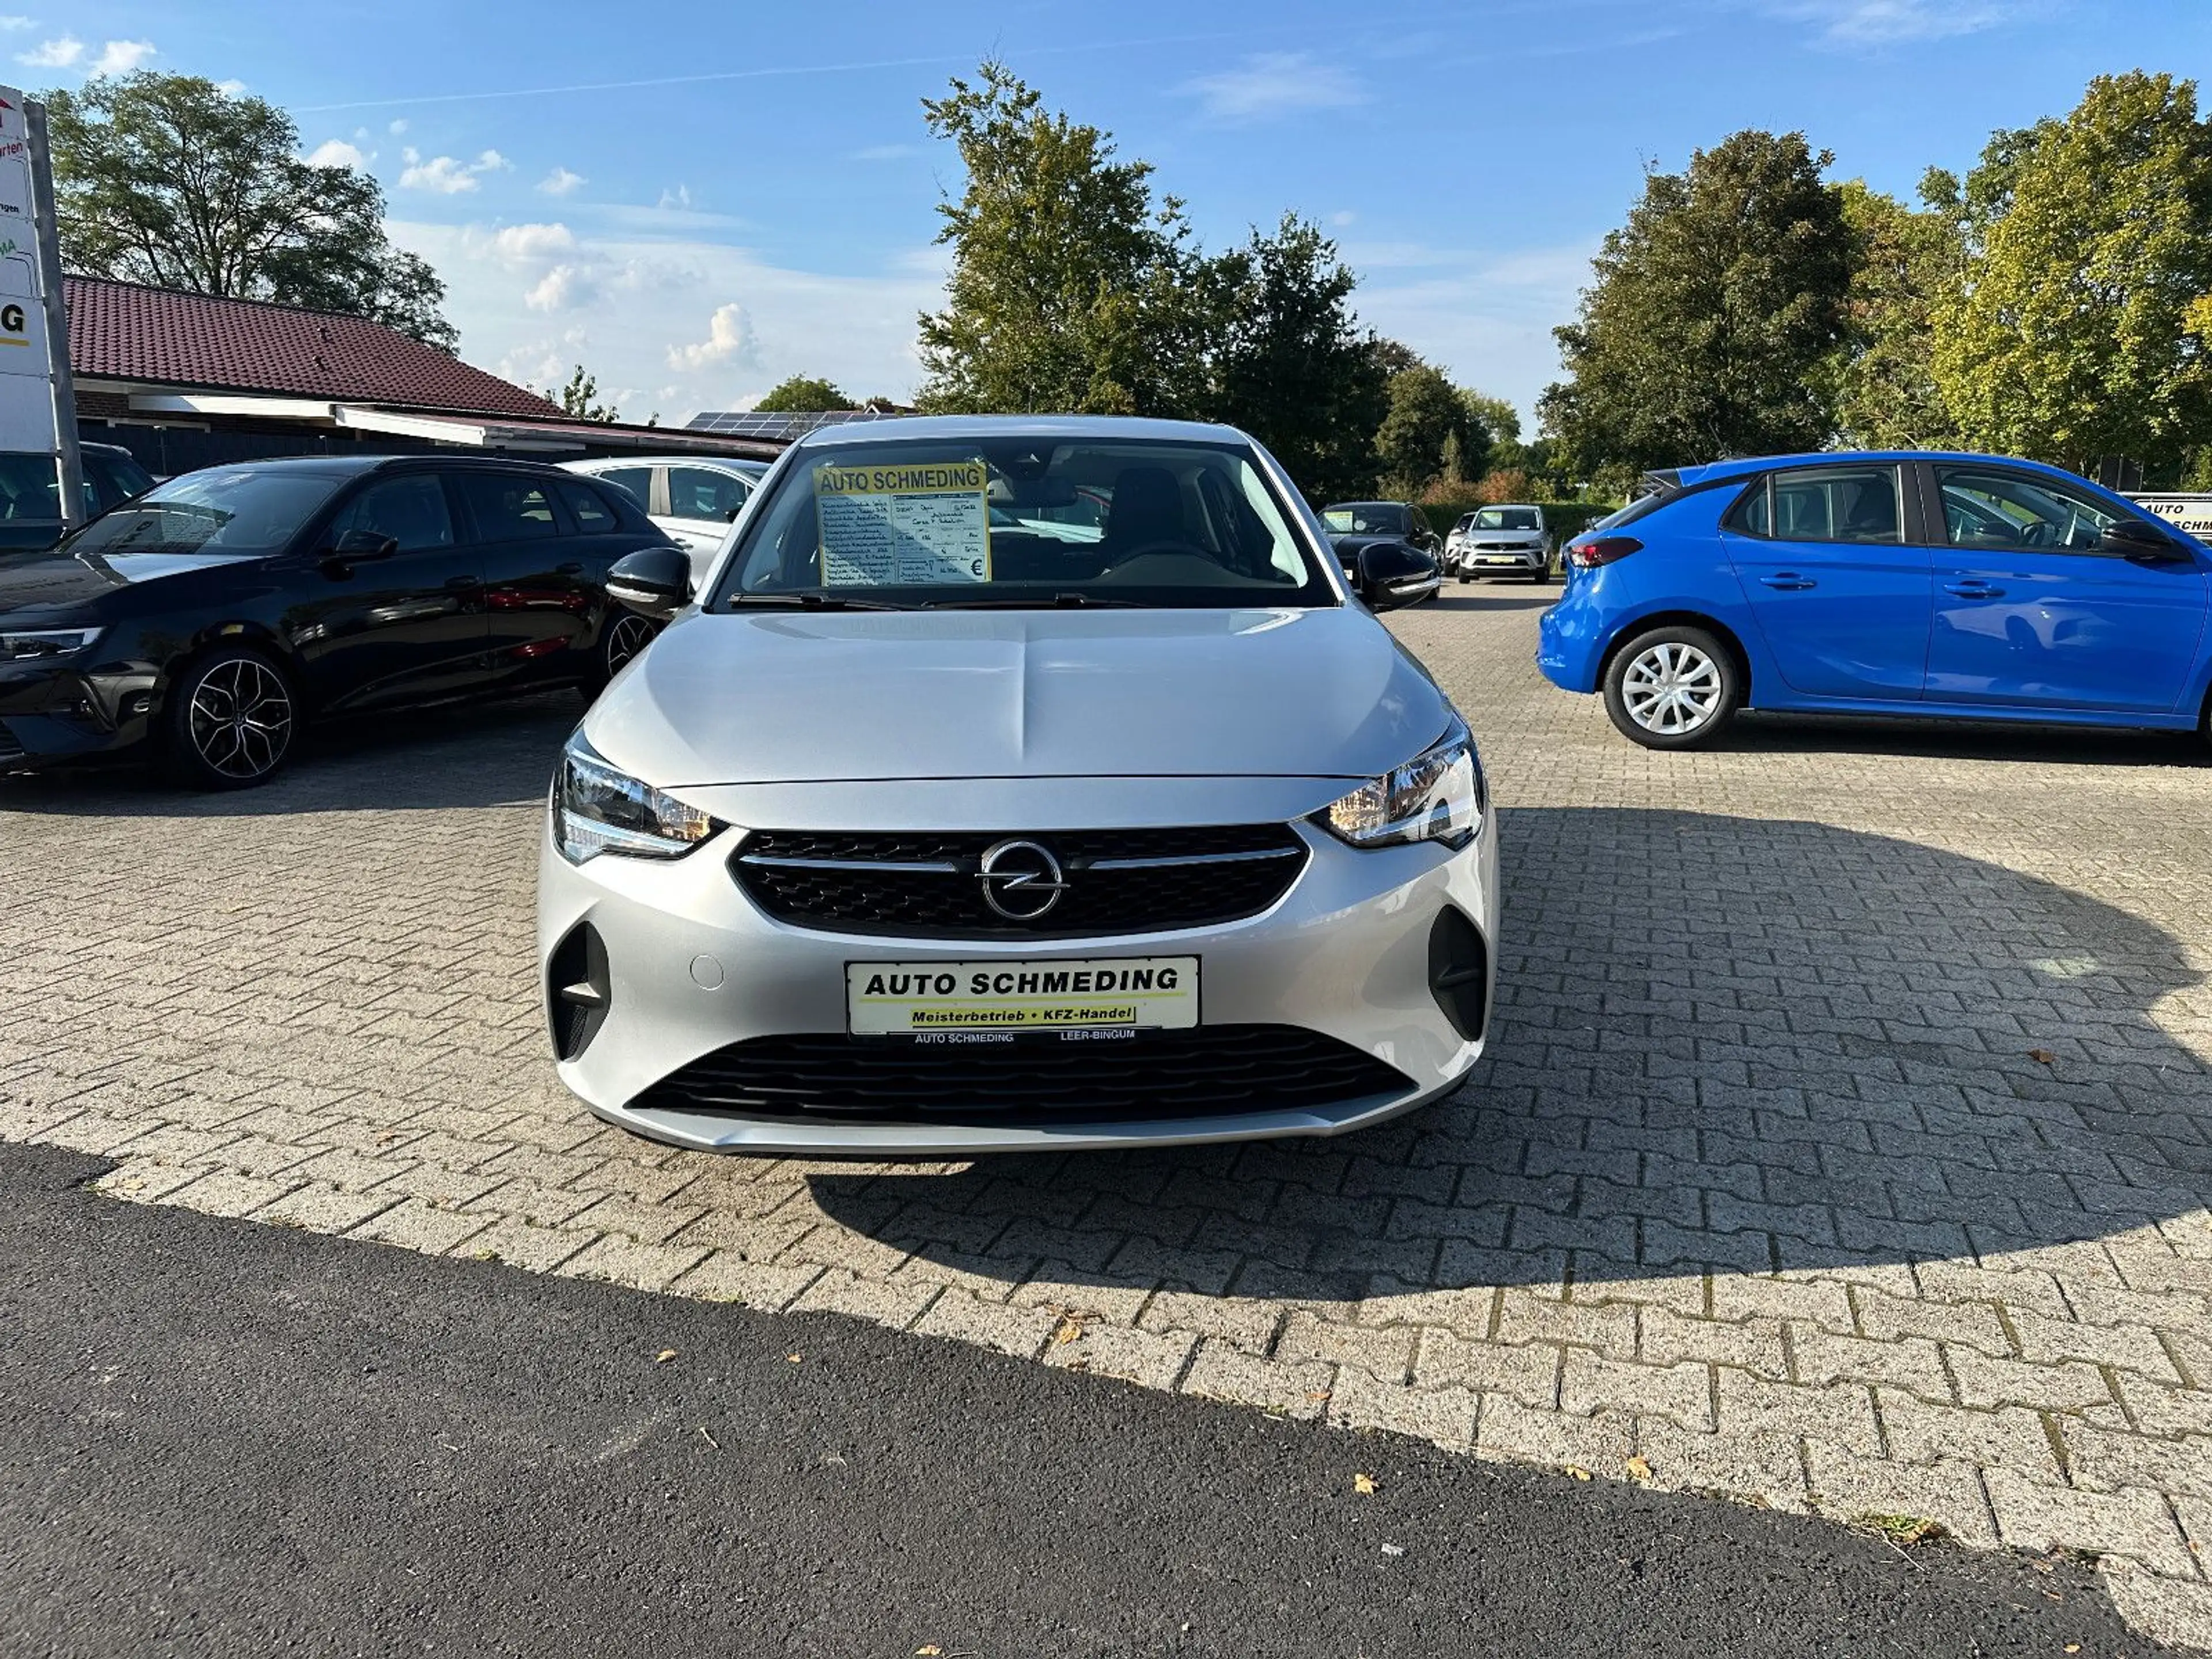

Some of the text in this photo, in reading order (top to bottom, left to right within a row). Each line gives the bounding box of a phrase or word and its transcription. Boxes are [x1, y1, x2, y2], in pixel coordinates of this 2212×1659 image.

[821, 468, 980, 491] AUTO SCHMEDING
[2146, 504, 2184, 514] AUTO
[971, 559, 983, 576] €
[864, 968, 1178, 995] AUTO SCHMEDING
[912, 1007, 1131, 1022] Meisterbetrieb KFZ-Handel
[915, 1029, 1135, 1044] AUTO SCHMEDING LEER-BINGUM
